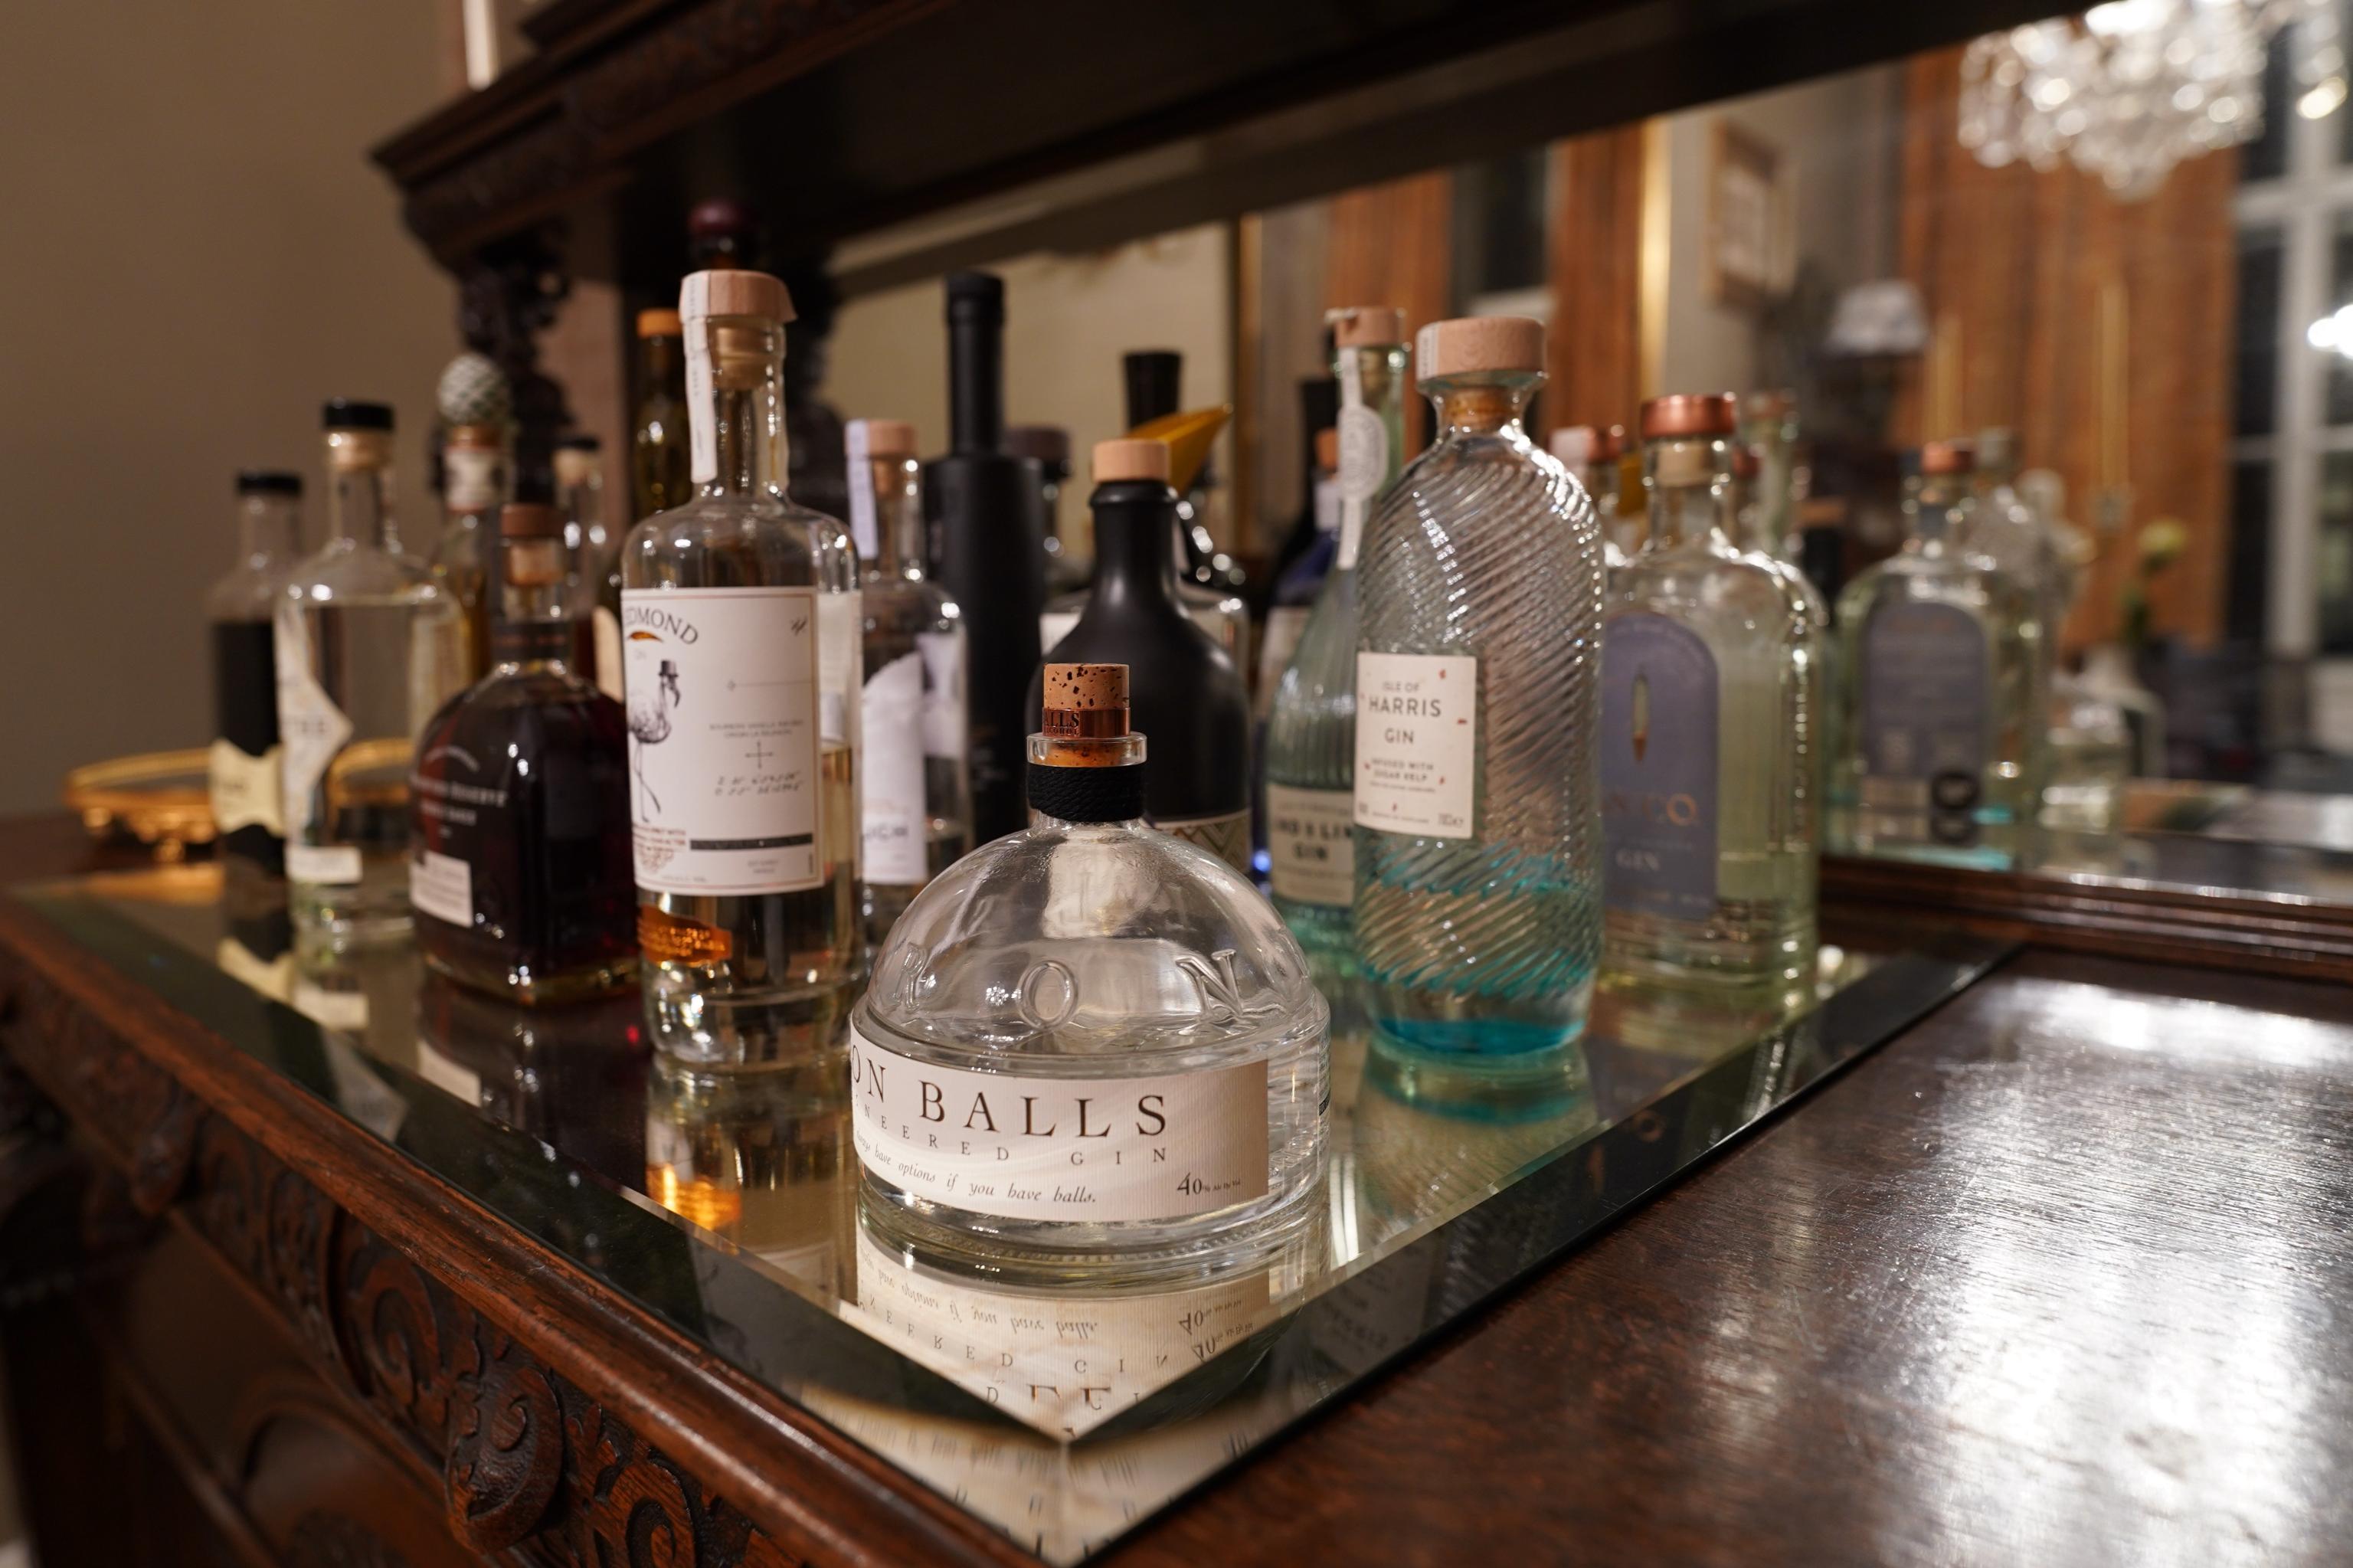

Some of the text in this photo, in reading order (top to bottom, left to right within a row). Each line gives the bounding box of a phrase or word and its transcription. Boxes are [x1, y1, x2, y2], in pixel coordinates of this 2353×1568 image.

[1368, 696, 1442, 718] HARRIS
[1384, 727, 1415, 744] GIN
[918, 1079, 1167, 1138] BALLS
[1070, 1146, 1167, 1166] GIN
[898, 1163, 936, 1183] options
[947, 1173, 959, 1191] if
[968, 1183, 996, 1196] you
[1007, 1183, 1042, 1201] have
[1053, 1186, 1097, 1203] balls.
